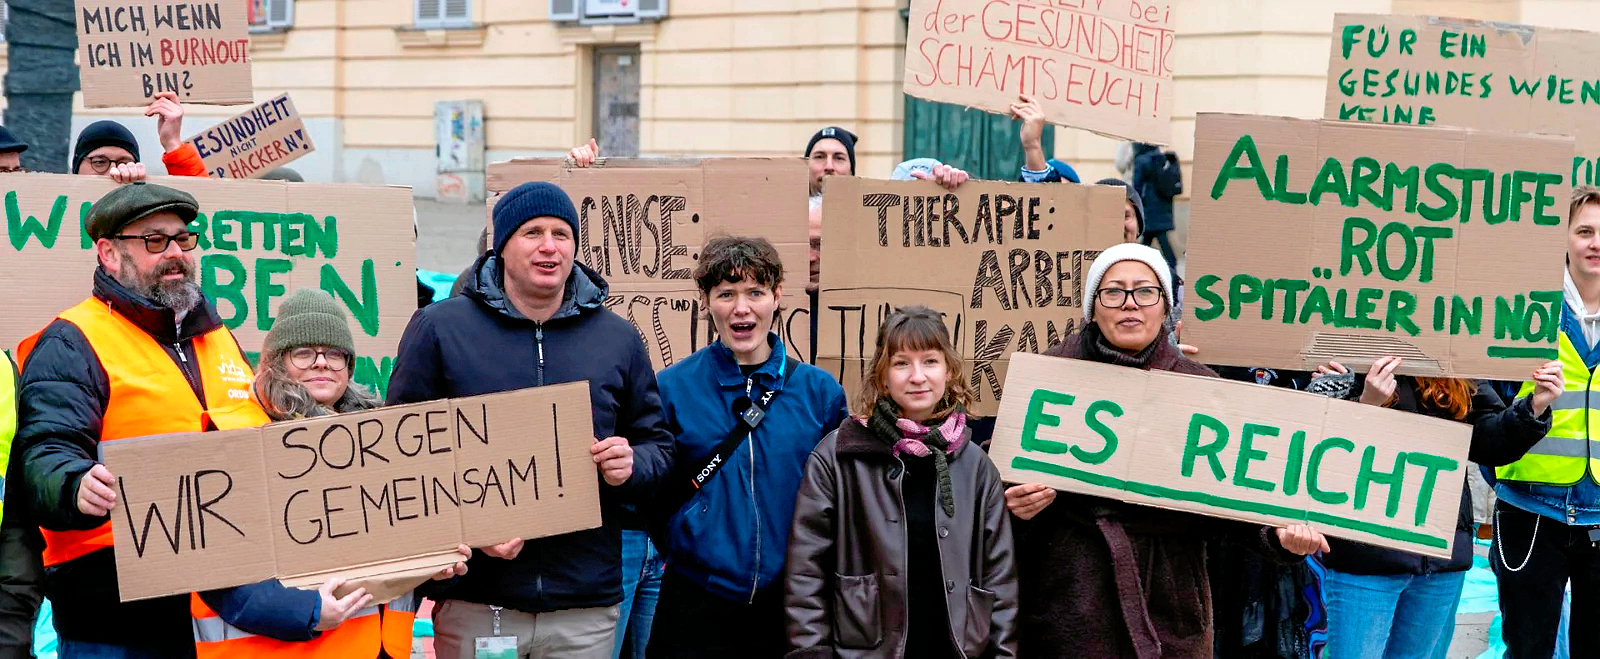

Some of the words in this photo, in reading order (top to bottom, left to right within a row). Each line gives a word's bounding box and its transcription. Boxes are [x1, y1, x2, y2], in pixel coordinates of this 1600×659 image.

[83, 6, 149, 36] MICH,
[153, 3, 222, 30] WENN
[924, 0, 975, 34] der
[1342, 24, 1417, 60] FÜR
[1440, 29, 1486, 58] EIN
[87, 42, 127, 67] ICH
[130, 41, 154, 66] IM
[160, 38, 248, 65] BURNOUT
[915, 38, 1057, 100] SCHÄMTS
[1338, 68, 1493, 98] GESUNDES
[142, 70, 194, 98] BIN?
[188, 96, 290, 158] ESUNDHEIT
[230, 138, 257, 157] NICHT
[1210, 134, 1563, 226] ALARMSTUFE
[4, 190, 94, 252] WI
[581, 193, 700, 280] GNOSE:
[863, 193, 1055, 247] THERAPIE:
[1339, 217, 1453, 282] ROT
[200, 253, 379, 337] BEN
[670, 299, 690, 312] UND
[1194, 266, 1421, 337] SPITÄLER
[1432, 295, 1482, 336] IN
[1493, 290, 1563, 343] NOT
[278, 403, 489, 480] SORGEN
[696, 453, 722, 483] SONY
[1021, 388, 1124, 465] ES
[1181, 412, 1458, 527] REICHT
[118, 469, 246, 558] WIR
